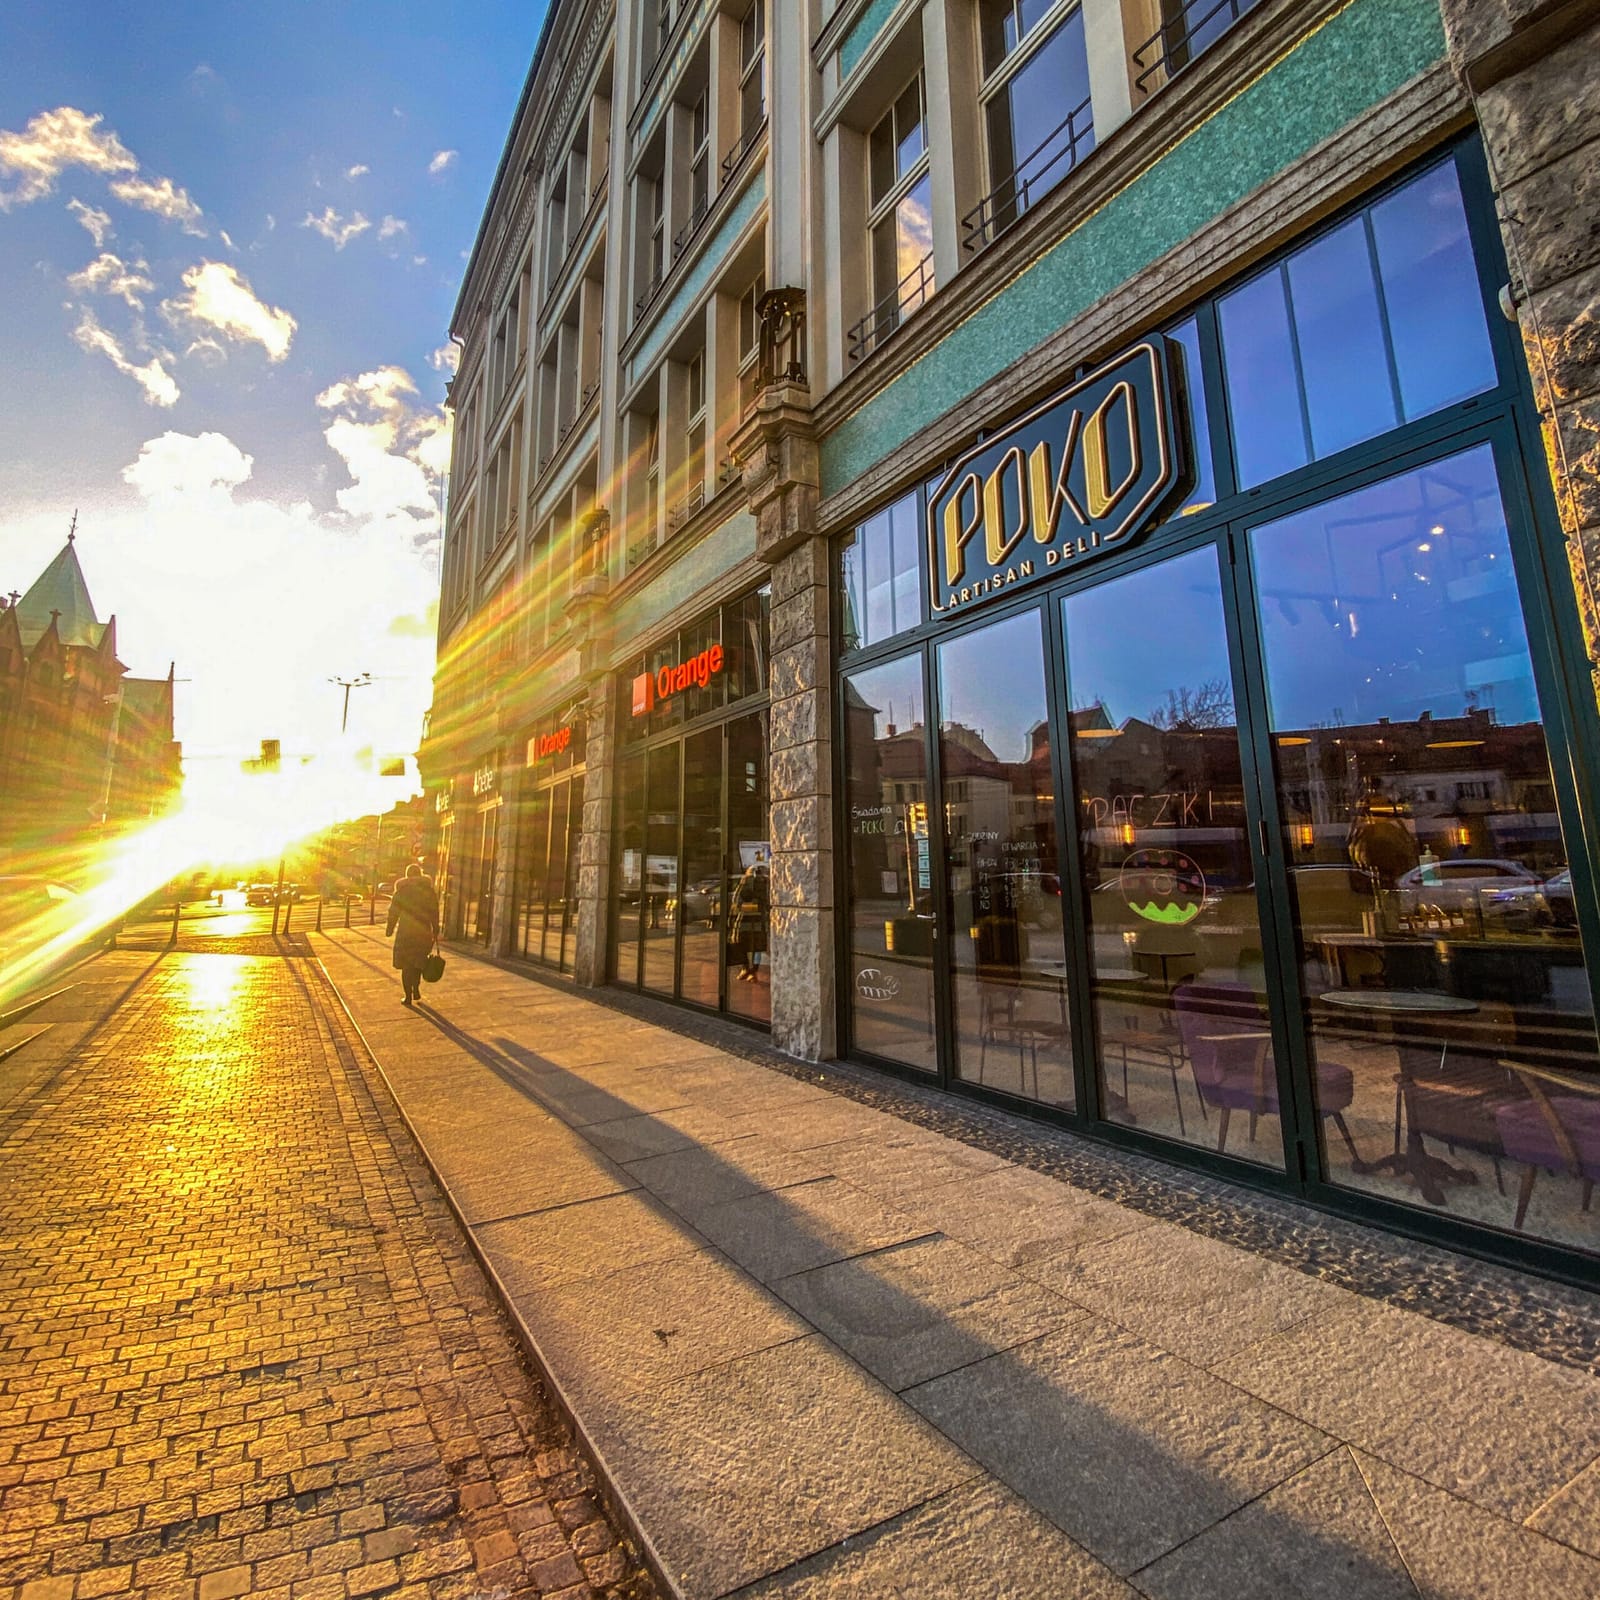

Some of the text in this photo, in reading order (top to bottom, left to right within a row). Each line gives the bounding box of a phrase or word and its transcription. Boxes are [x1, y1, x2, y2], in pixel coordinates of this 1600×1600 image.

[944, 381, 1142, 586] POKO
[948, 531, 1100, 608] ARTISAN DELI
[658, 643, 723, 699] Orange
[540, 726, 570, 757] Orange
